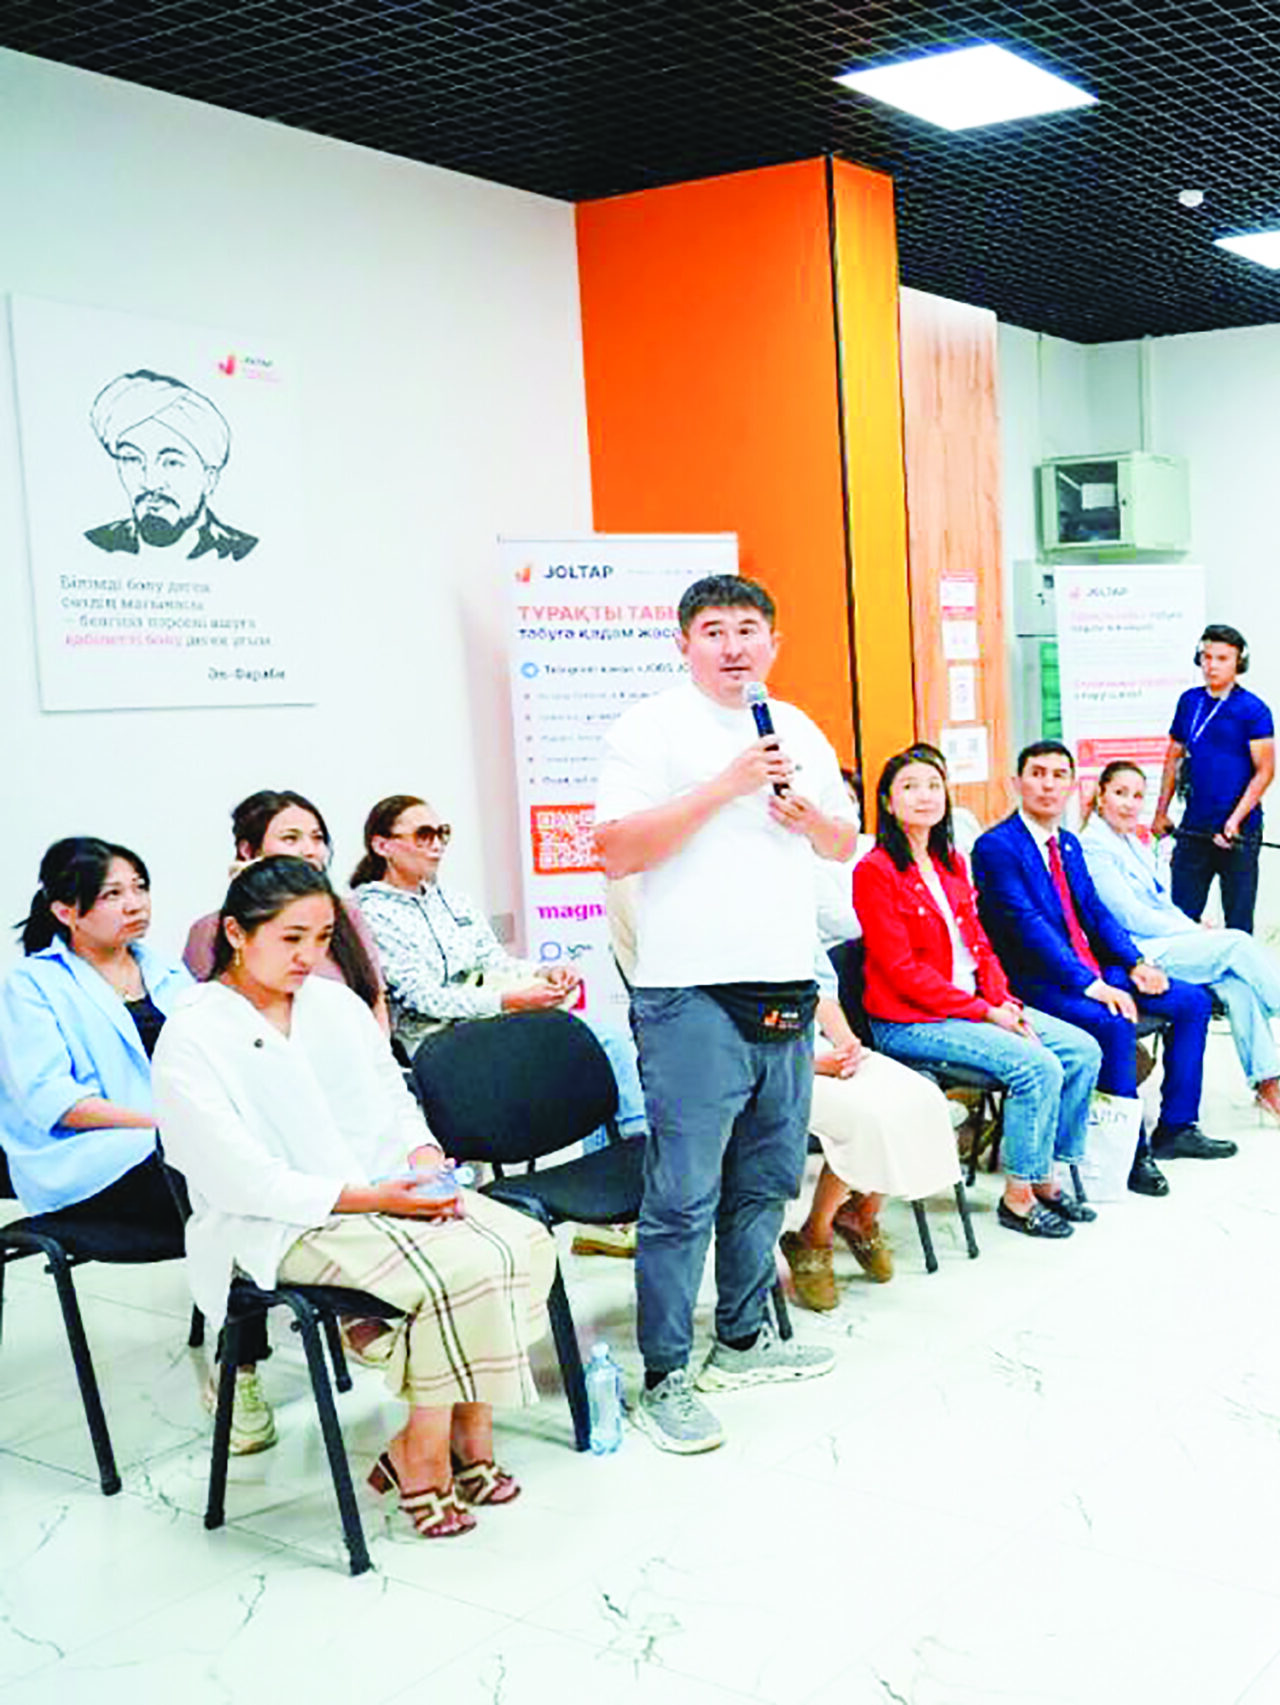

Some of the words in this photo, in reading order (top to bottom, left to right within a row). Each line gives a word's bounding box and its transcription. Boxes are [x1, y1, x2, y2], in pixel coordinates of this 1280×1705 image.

[544, 565, 614, 579] JOLTAP
[627, 605, 682, 621] ТАБЫ
[537, 903, 606, 921] magn
